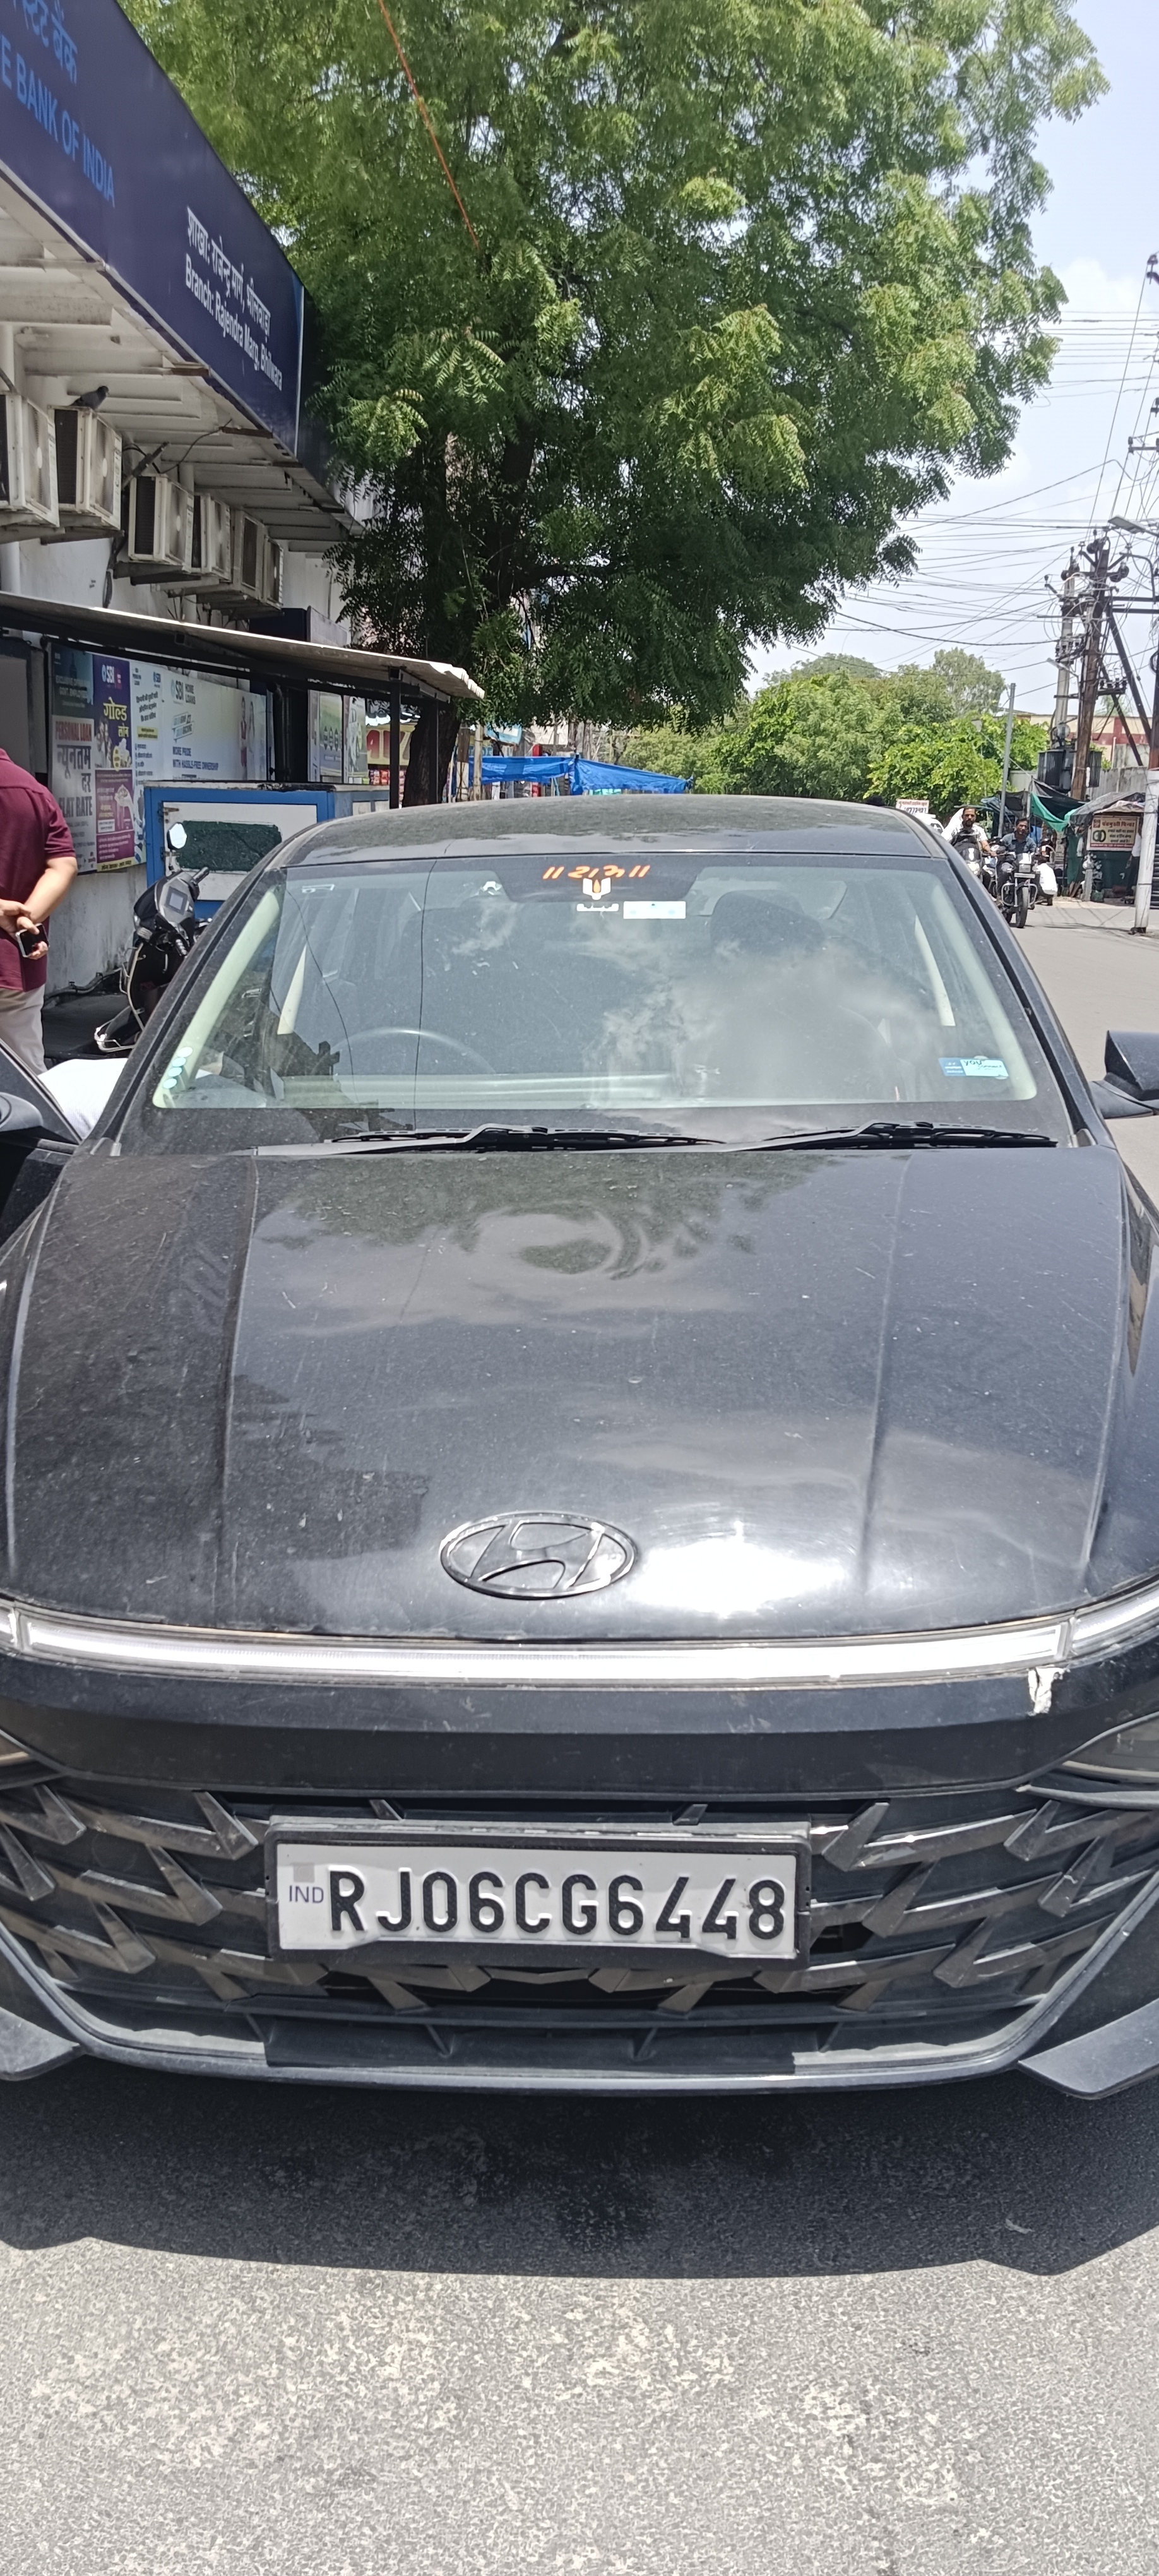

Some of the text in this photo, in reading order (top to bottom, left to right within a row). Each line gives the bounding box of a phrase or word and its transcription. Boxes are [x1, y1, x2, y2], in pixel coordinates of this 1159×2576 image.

[16, 52, 59, 143] BANK
[62, 109, 79, 163] OF
[83, 133, 116, 208] INDIA
[187, 205, 211, 266] शाखा:
[186, 253, 215, 316] Branch:
[215, 290, 244, 349] Rajendra
[261, 342, 283, 391] Bhilwara
[175, 679, 184, 701] SBI
[185, 683, 195, 695] HOME
[103, 696, 128, 721] गोल्ड
[185, 695, 196, 705] LOANS
[80, 723, 92, 742] LOAN
[117, 722, 129, 739] लोन
[56, 744, 92, 780] न्यूनतम
[172, 746, 192, 757] MORE PRIDE
[172, 759, 181, 768] WITH
[81, 773, 92, 794] दर
[76, 796, 93, 817] RATE
[289, 1884, 324, 1904] IND
[330, 1869, 785, 1940] RJ06CG6448
